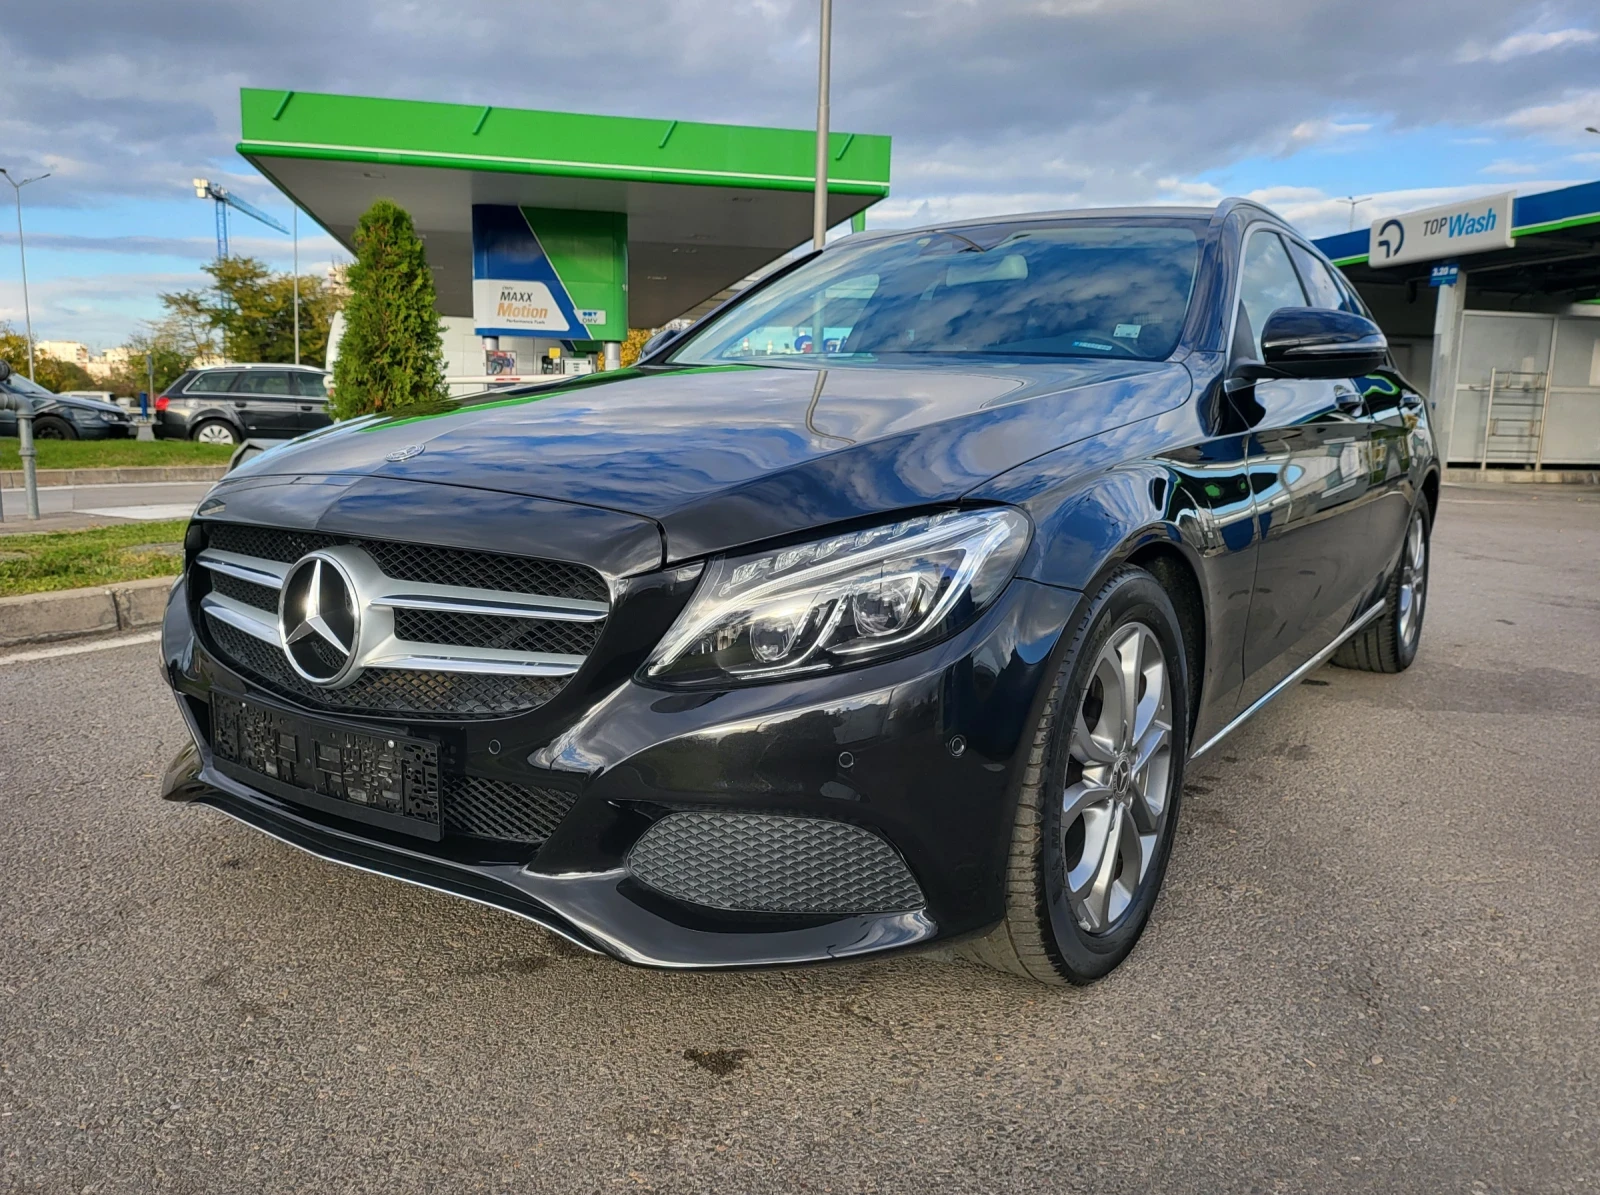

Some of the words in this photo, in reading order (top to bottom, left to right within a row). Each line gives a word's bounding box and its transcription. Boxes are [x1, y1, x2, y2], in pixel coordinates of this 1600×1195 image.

[1423, 217, 1448, 237] TOP
[1449, 207, 1497, 238] Wash
[500, 291, 533, 302] MAXX
[497, 303, 548, 318] Motion
